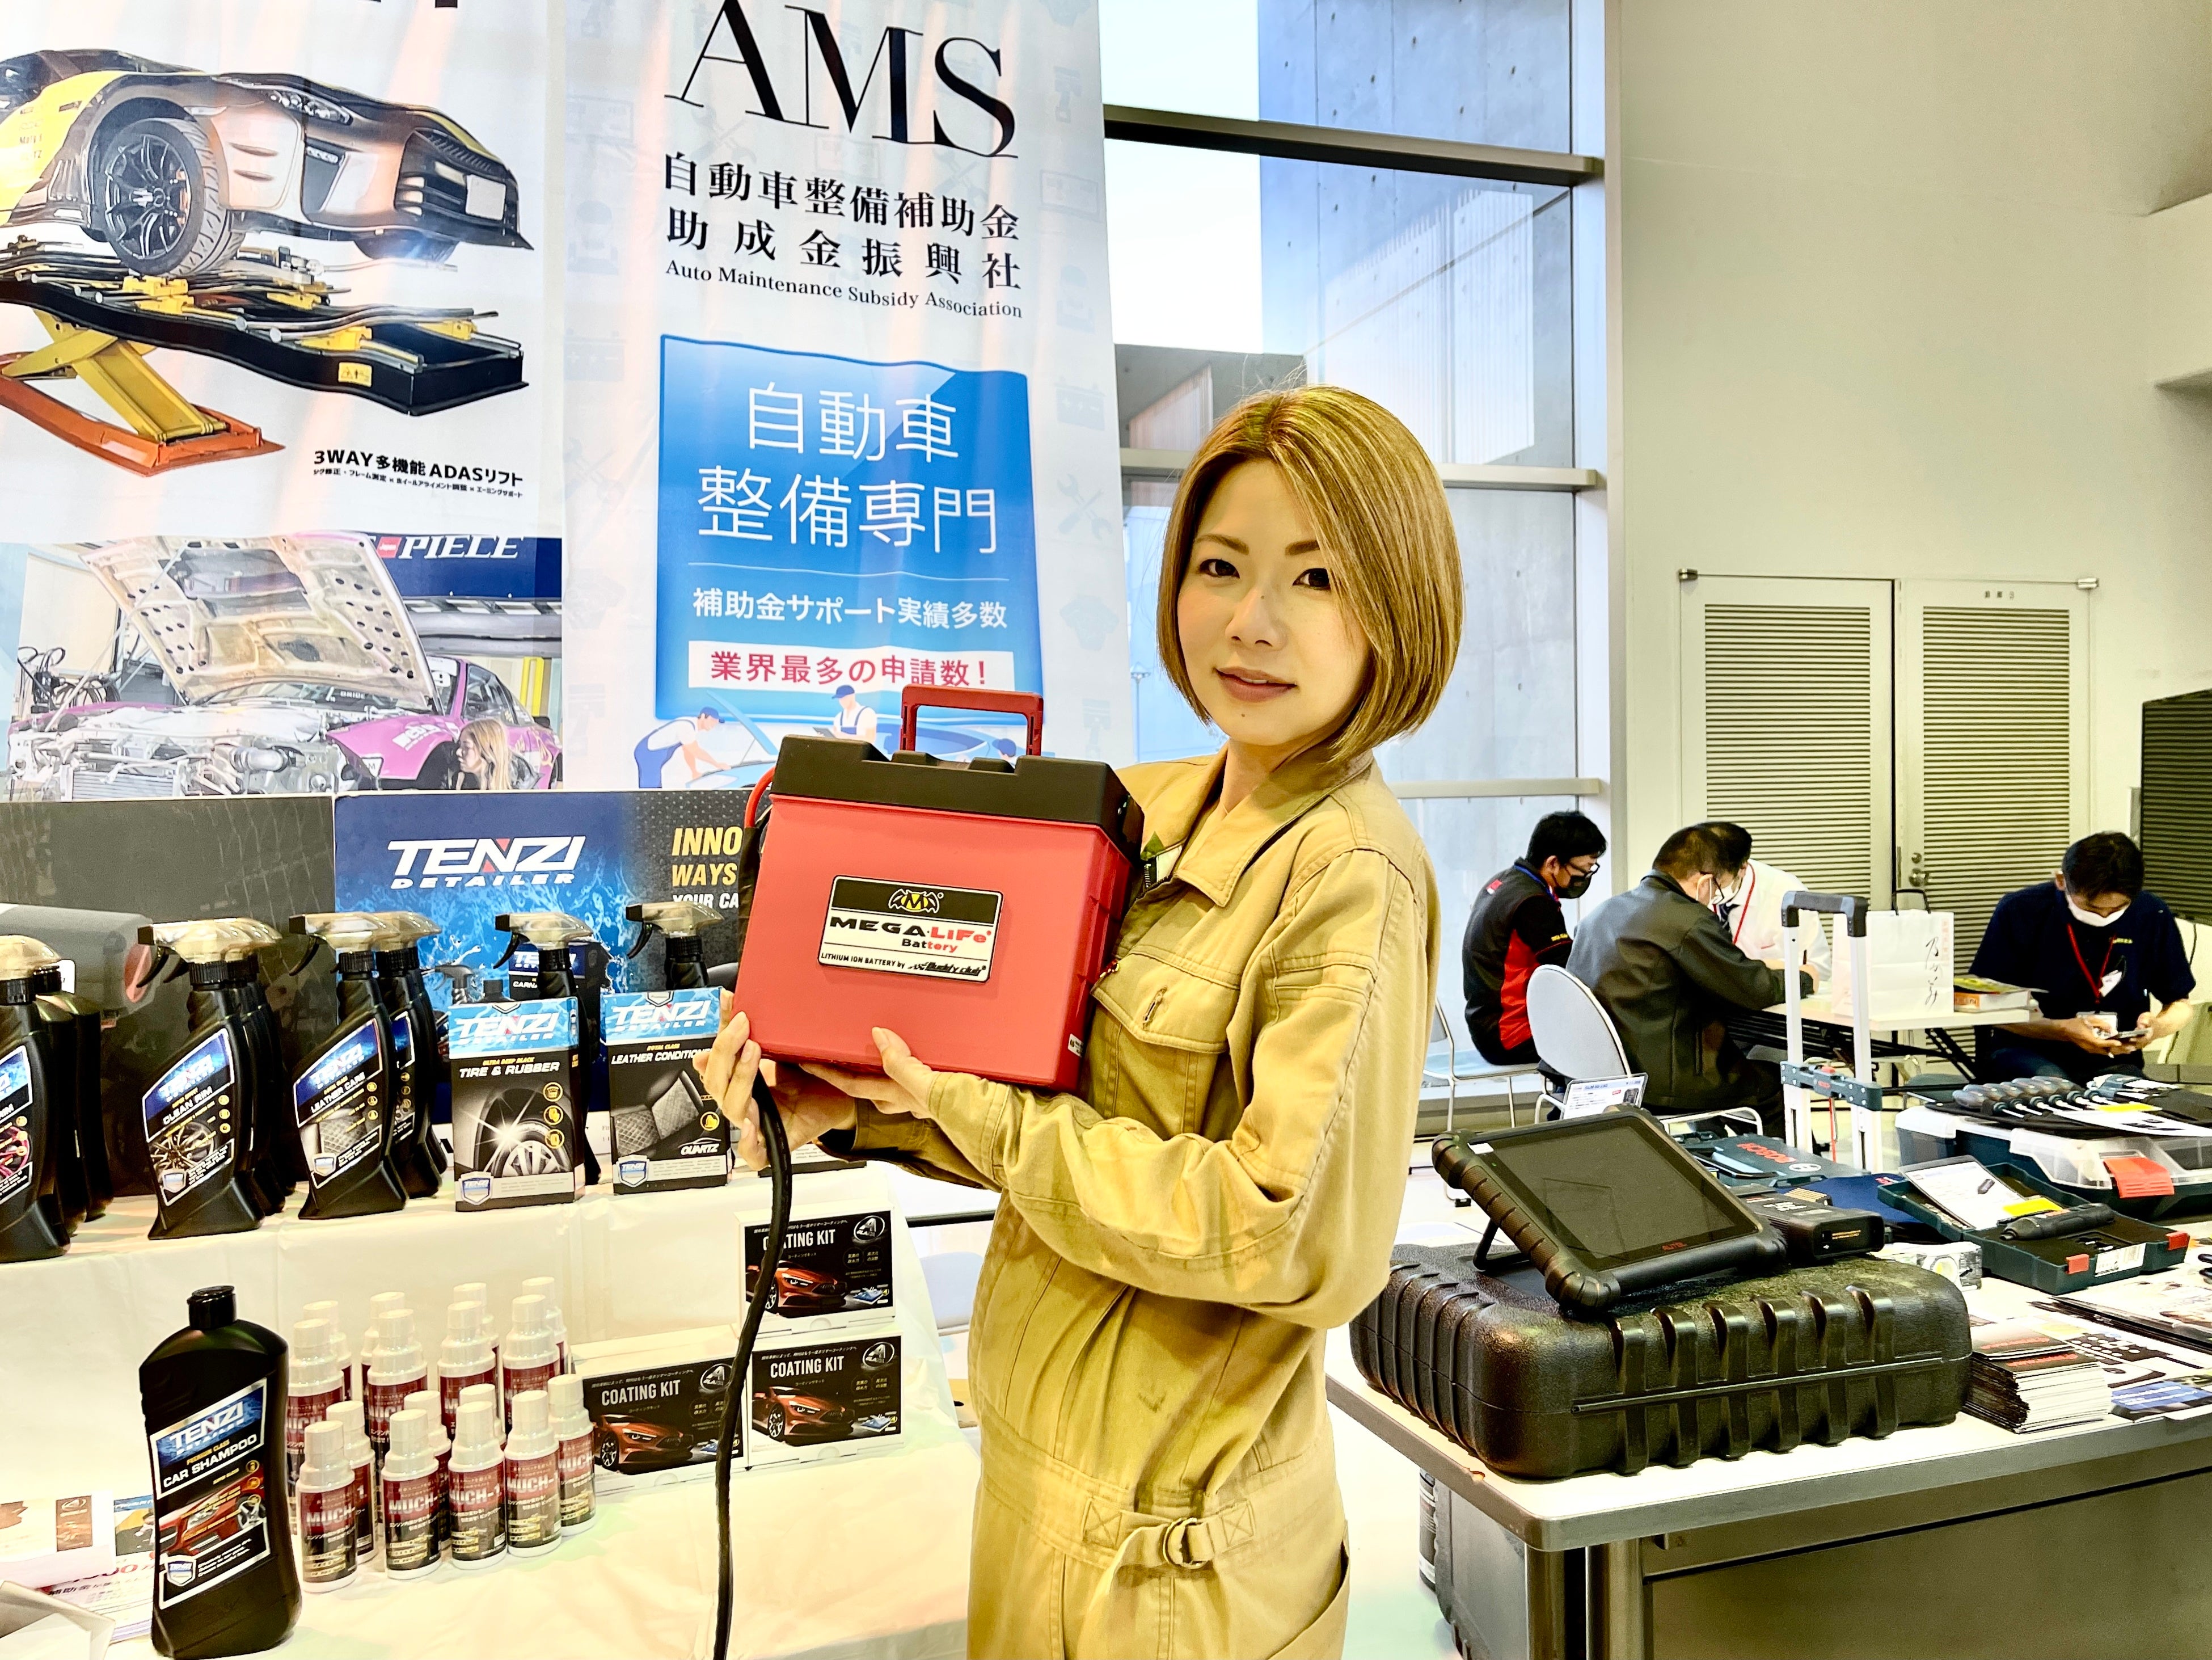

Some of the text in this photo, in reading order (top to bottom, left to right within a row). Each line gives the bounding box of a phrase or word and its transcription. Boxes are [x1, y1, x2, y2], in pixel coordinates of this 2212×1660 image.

[664, 0, 1018, 158] AMS
[665, 151, 1019, 241] 自動車整備補助金
[666, 207, 1021, 289] 助成金振興社
[666, 260, 1023, 318] Auto Maintenance Subsidy Association
[749, 382, 959, 462] 自動車
[698, 465, 997, 554] 整備専門
[693, 587, 1008, 629] 補助金サポート実績多数
[387, 836, 586, 876] TENZI
[390, 873, 575, 890] DETAILER
[672, 863, 738, 887] WAYS
[901, 938, 958, 953] Battery
[821, 953, 849, 962] LITHIUM
[864, 957, 896, 967] BATTERY
[897, 960, 905, 969] by
[456, 1012, 560, 1038] TENZI
[613, 1000, 711, 1025] TENZI
[459, 1061, 560, 1078] TIRE & RUBBER
[611, 1053, 653, 1065] LEATHER
[817, 1229, 836, 1245] KIT
[770, 1356, 845, 1378] COATING KIT
[601, 1379, 681, 1406] COATING KIT
[170, 1401, 244, 1450] TENZI
[163, 1469, 189, 1488] CAR
[192, 1434, 257, 1475] SHAMPOO
